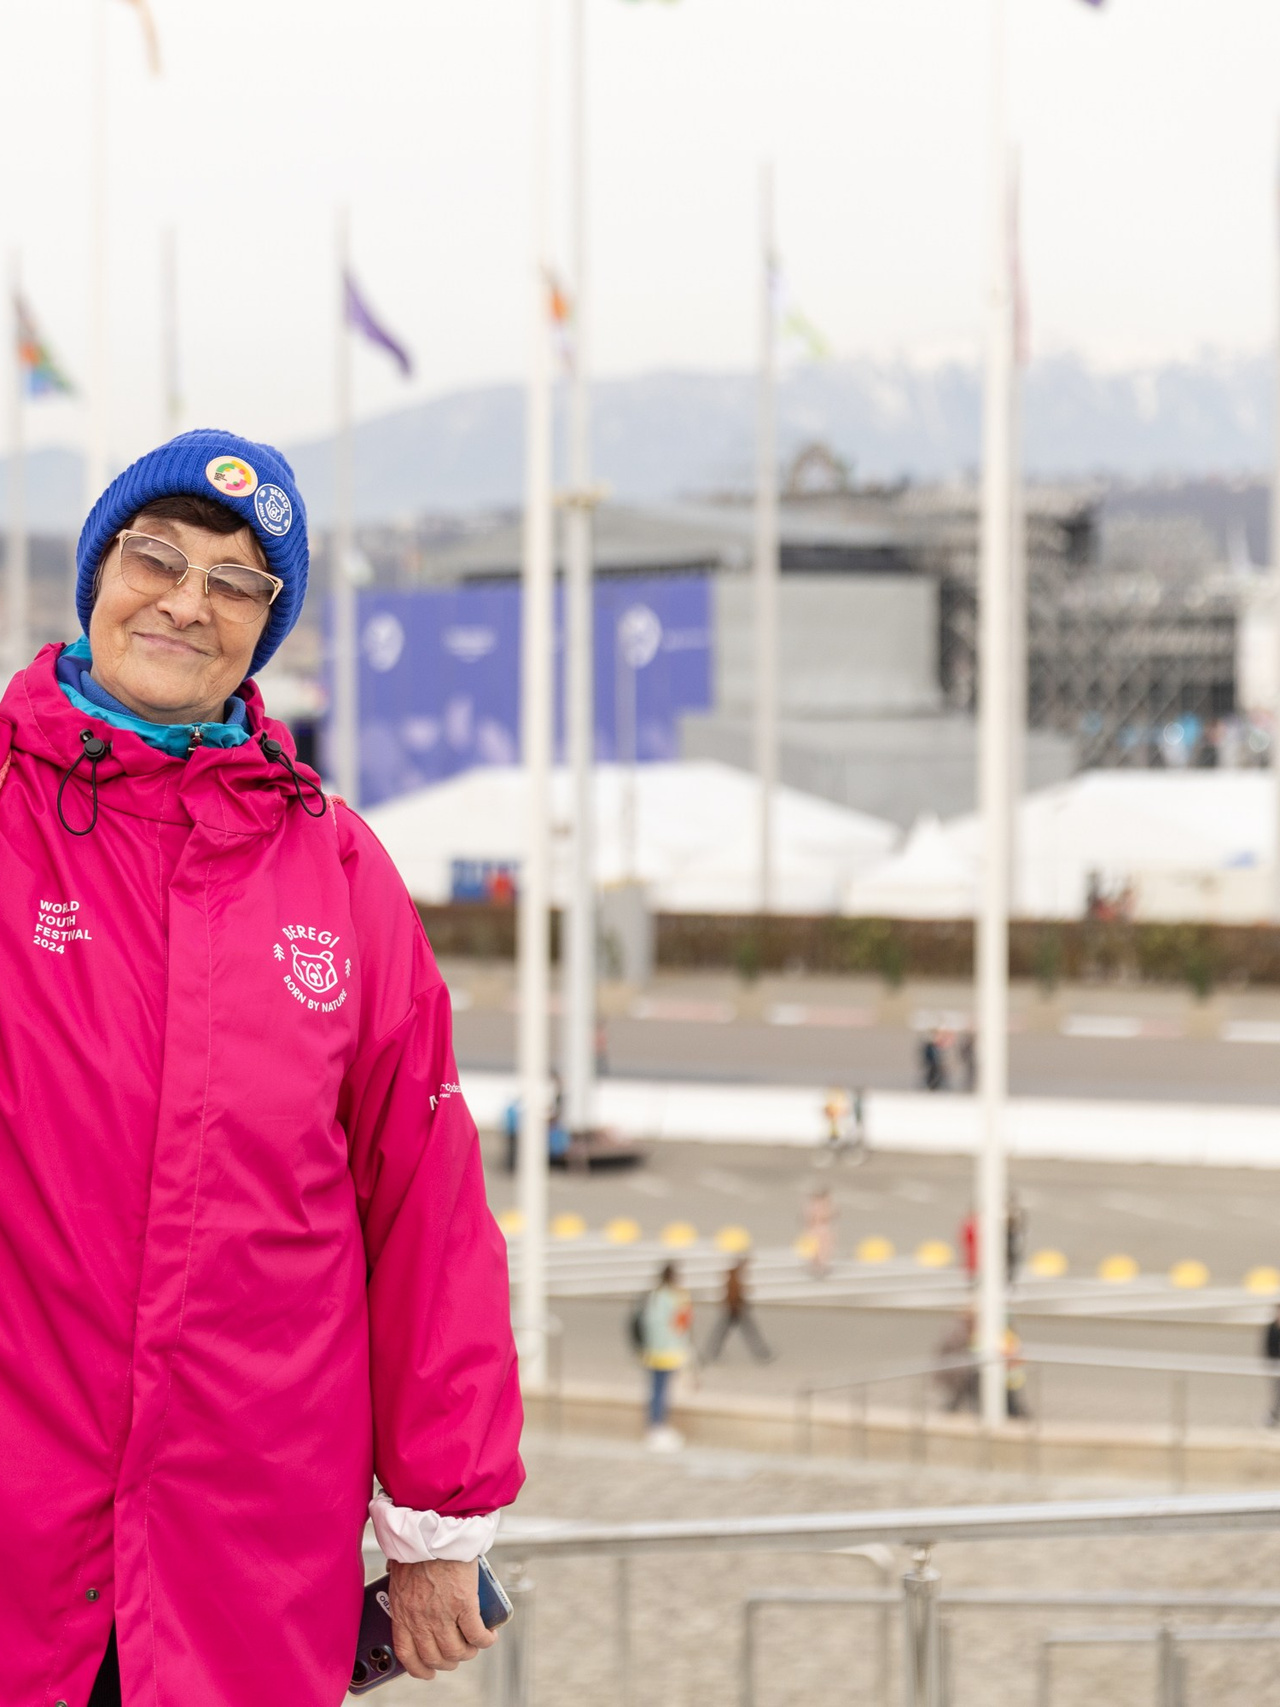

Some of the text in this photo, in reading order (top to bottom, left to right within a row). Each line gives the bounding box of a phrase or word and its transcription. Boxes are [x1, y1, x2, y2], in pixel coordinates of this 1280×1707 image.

[40, 899, 80, 914] WORLD
[38, 911, 76, 928] YOUTH
[35, 923, 93, 942] FESTIVAL
[282, 924, 340, 948] BEREGI
[33, 935, 65, 955] 2024
[283, 974, 348, 1013] BORN BY NATURE
